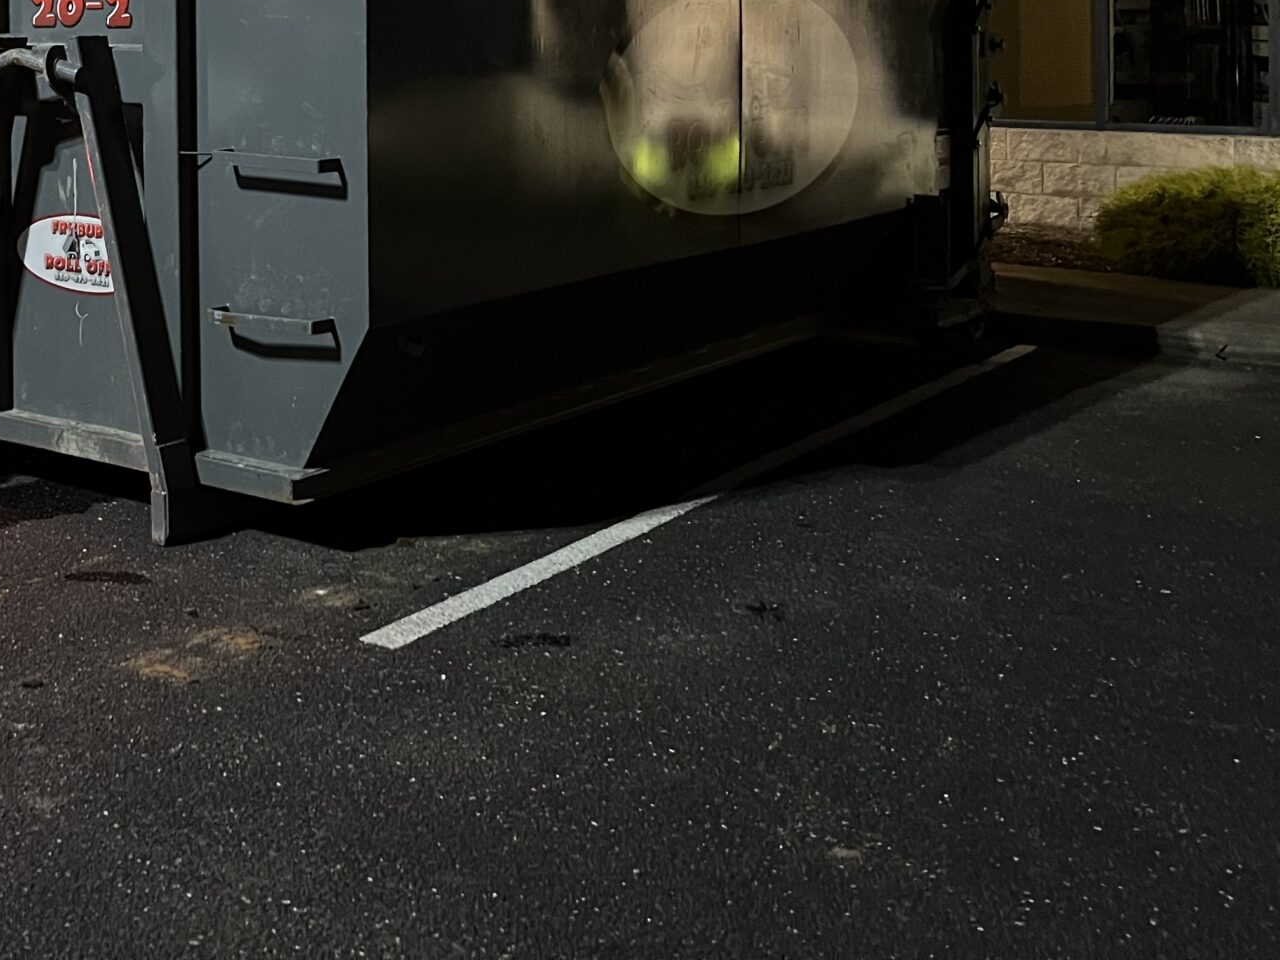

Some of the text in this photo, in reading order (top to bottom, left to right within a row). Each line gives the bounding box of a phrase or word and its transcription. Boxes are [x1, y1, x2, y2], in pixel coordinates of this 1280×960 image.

[52, 220, 104, 239] FRYBUR
[44, 253, 111, 277] ROLL OFF
